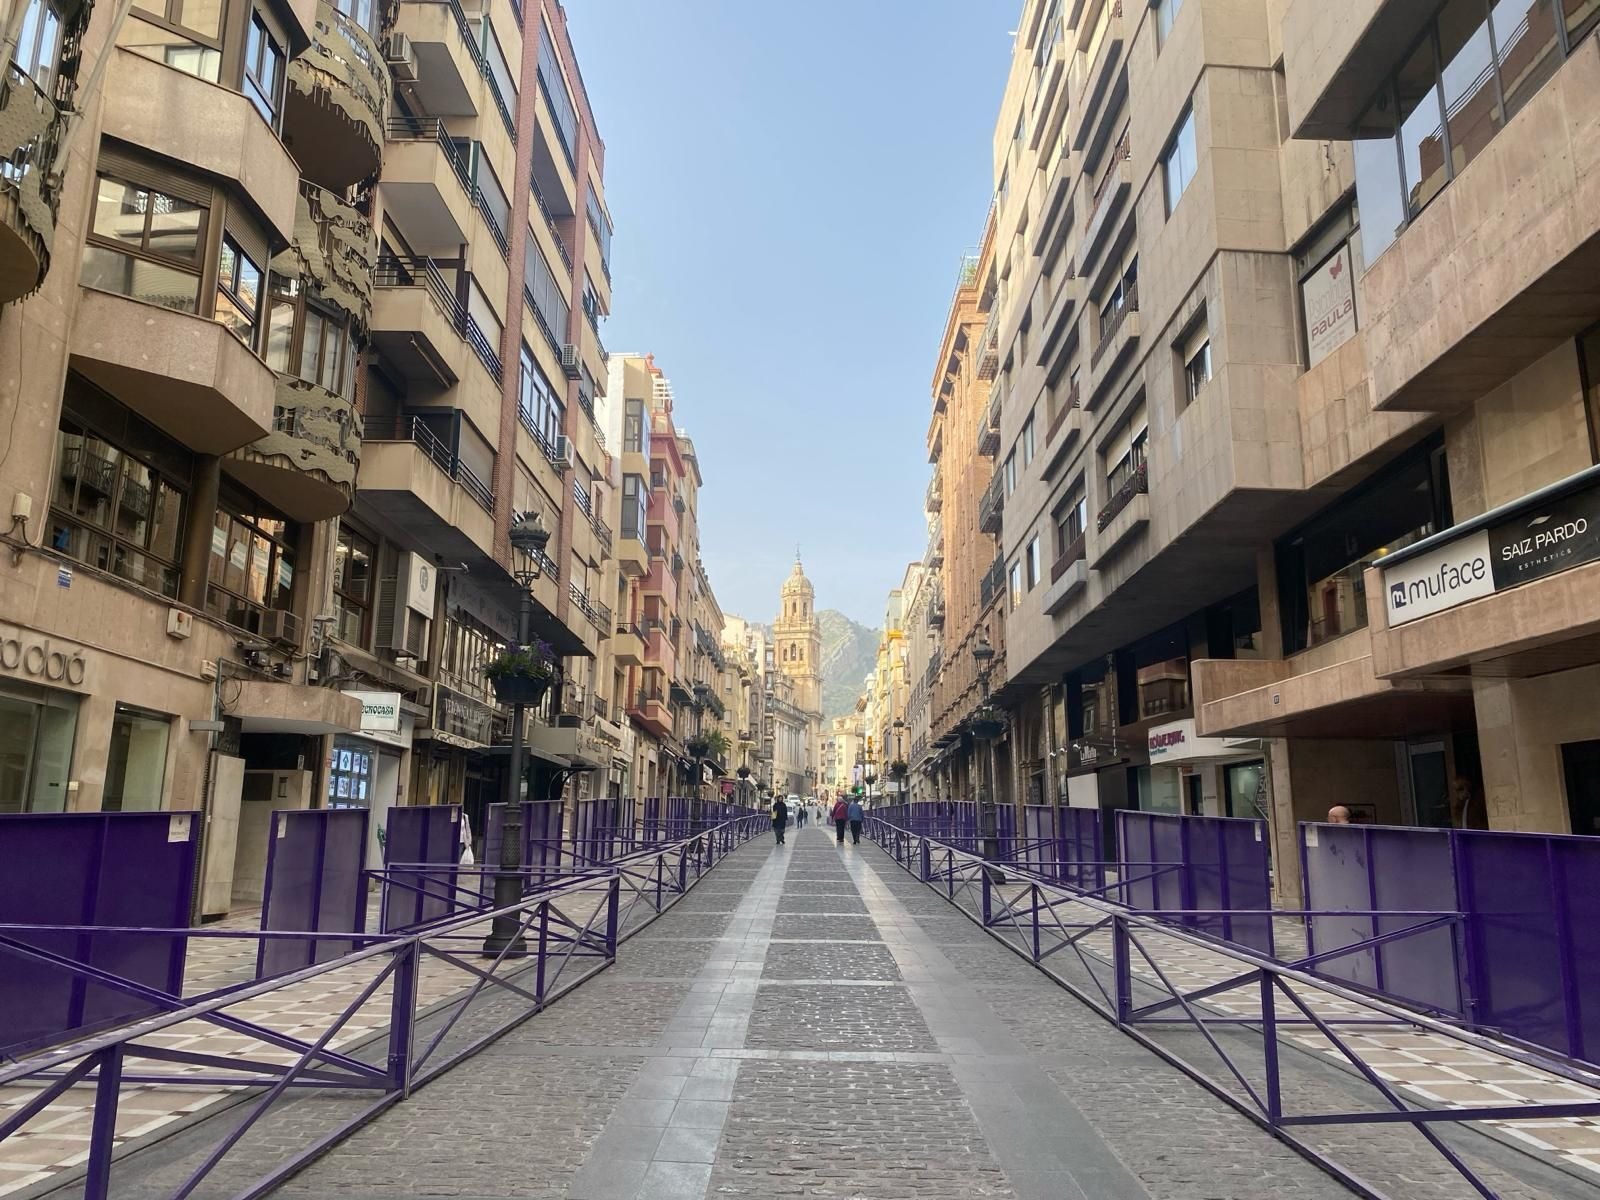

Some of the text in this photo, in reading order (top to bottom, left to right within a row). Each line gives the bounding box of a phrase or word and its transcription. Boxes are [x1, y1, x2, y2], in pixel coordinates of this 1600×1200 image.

[1502, 518, 1588, 561] SAIZ PARDO
[1518, 548, 1573, 571] ESTHETICS
[1409, 557, 1486, 605] muface
